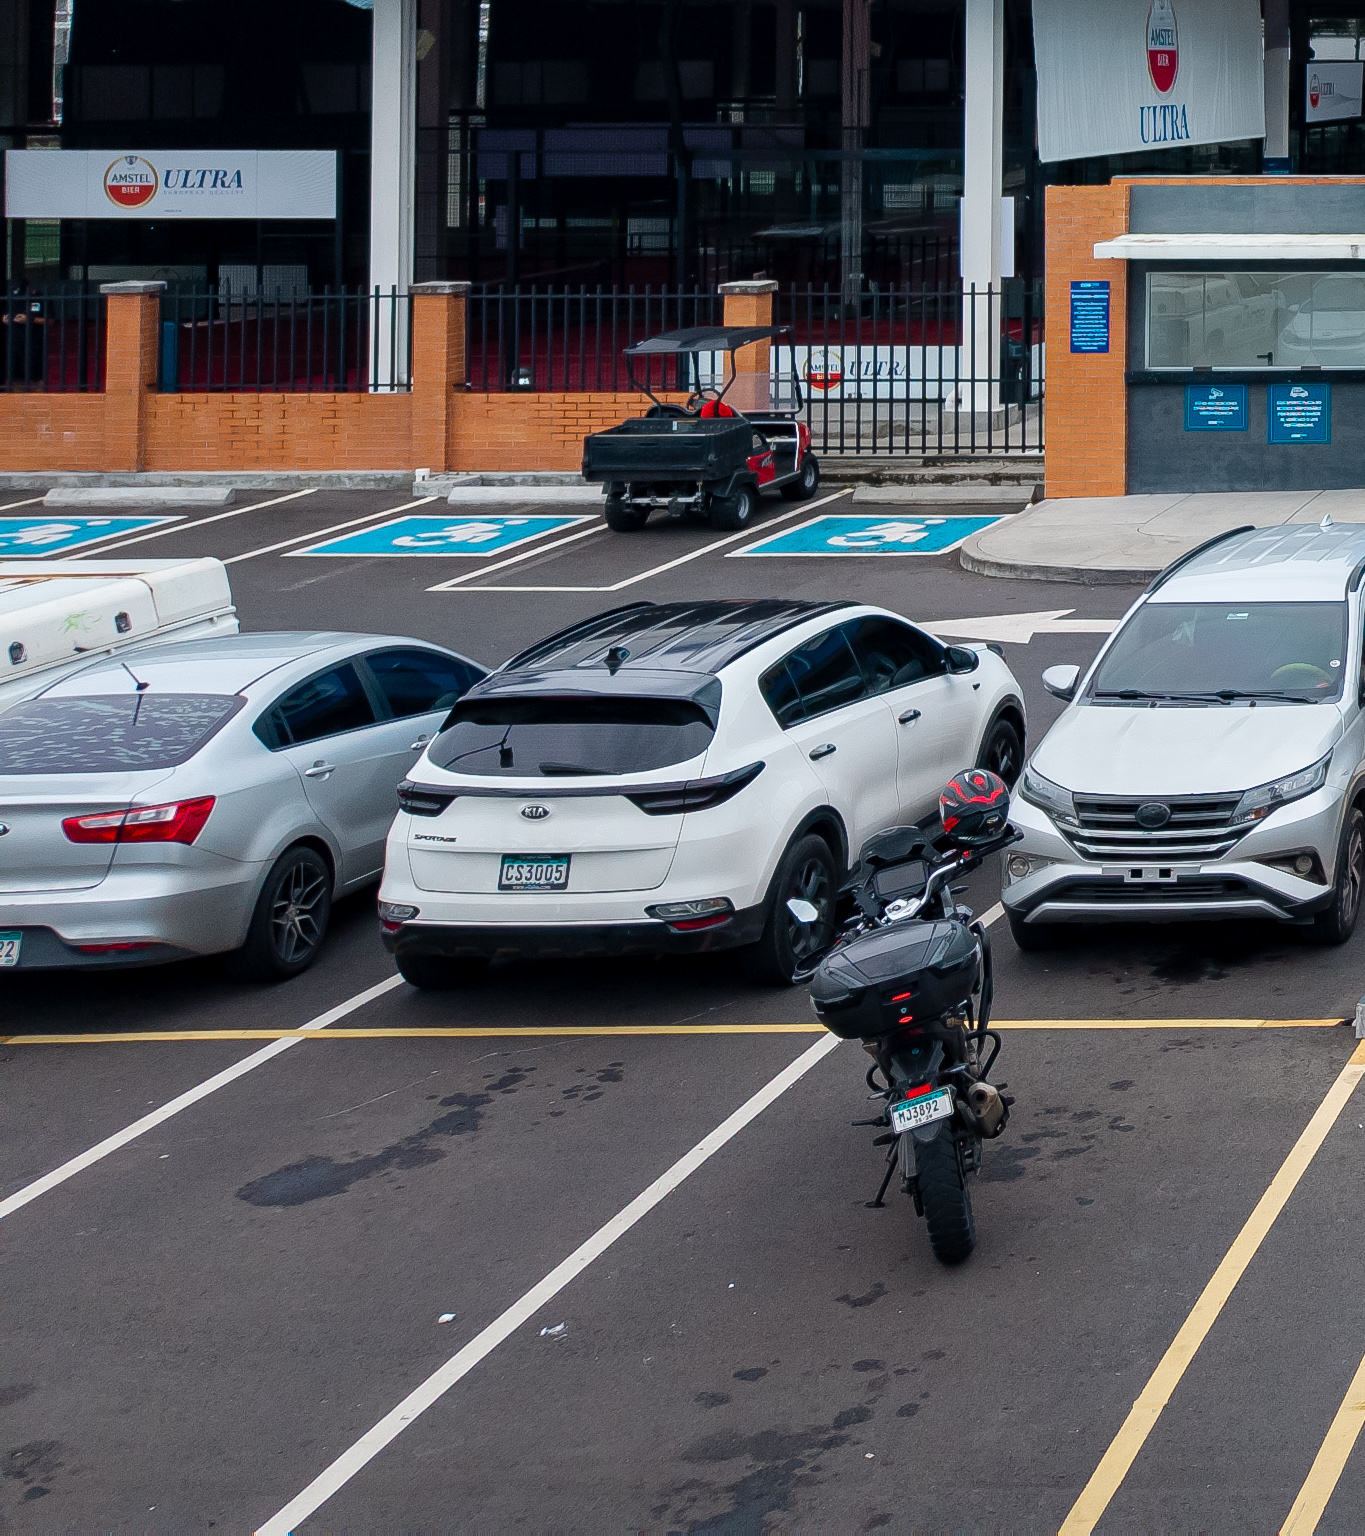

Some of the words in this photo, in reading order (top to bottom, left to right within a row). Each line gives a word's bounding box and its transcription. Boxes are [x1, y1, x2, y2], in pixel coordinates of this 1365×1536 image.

[1151, 28, 1175, 46] AMSTEL
[1139, 103, 1190, 144] ULTRA
[111, 173, 151, 183] AMSTEL
[163, 169, 243, 189] ULTRA
[524, 807, 545, 817] KIA
[505, 864, 564, 881] CS3005
[898, 1099, 940, 1124] MJ3892
